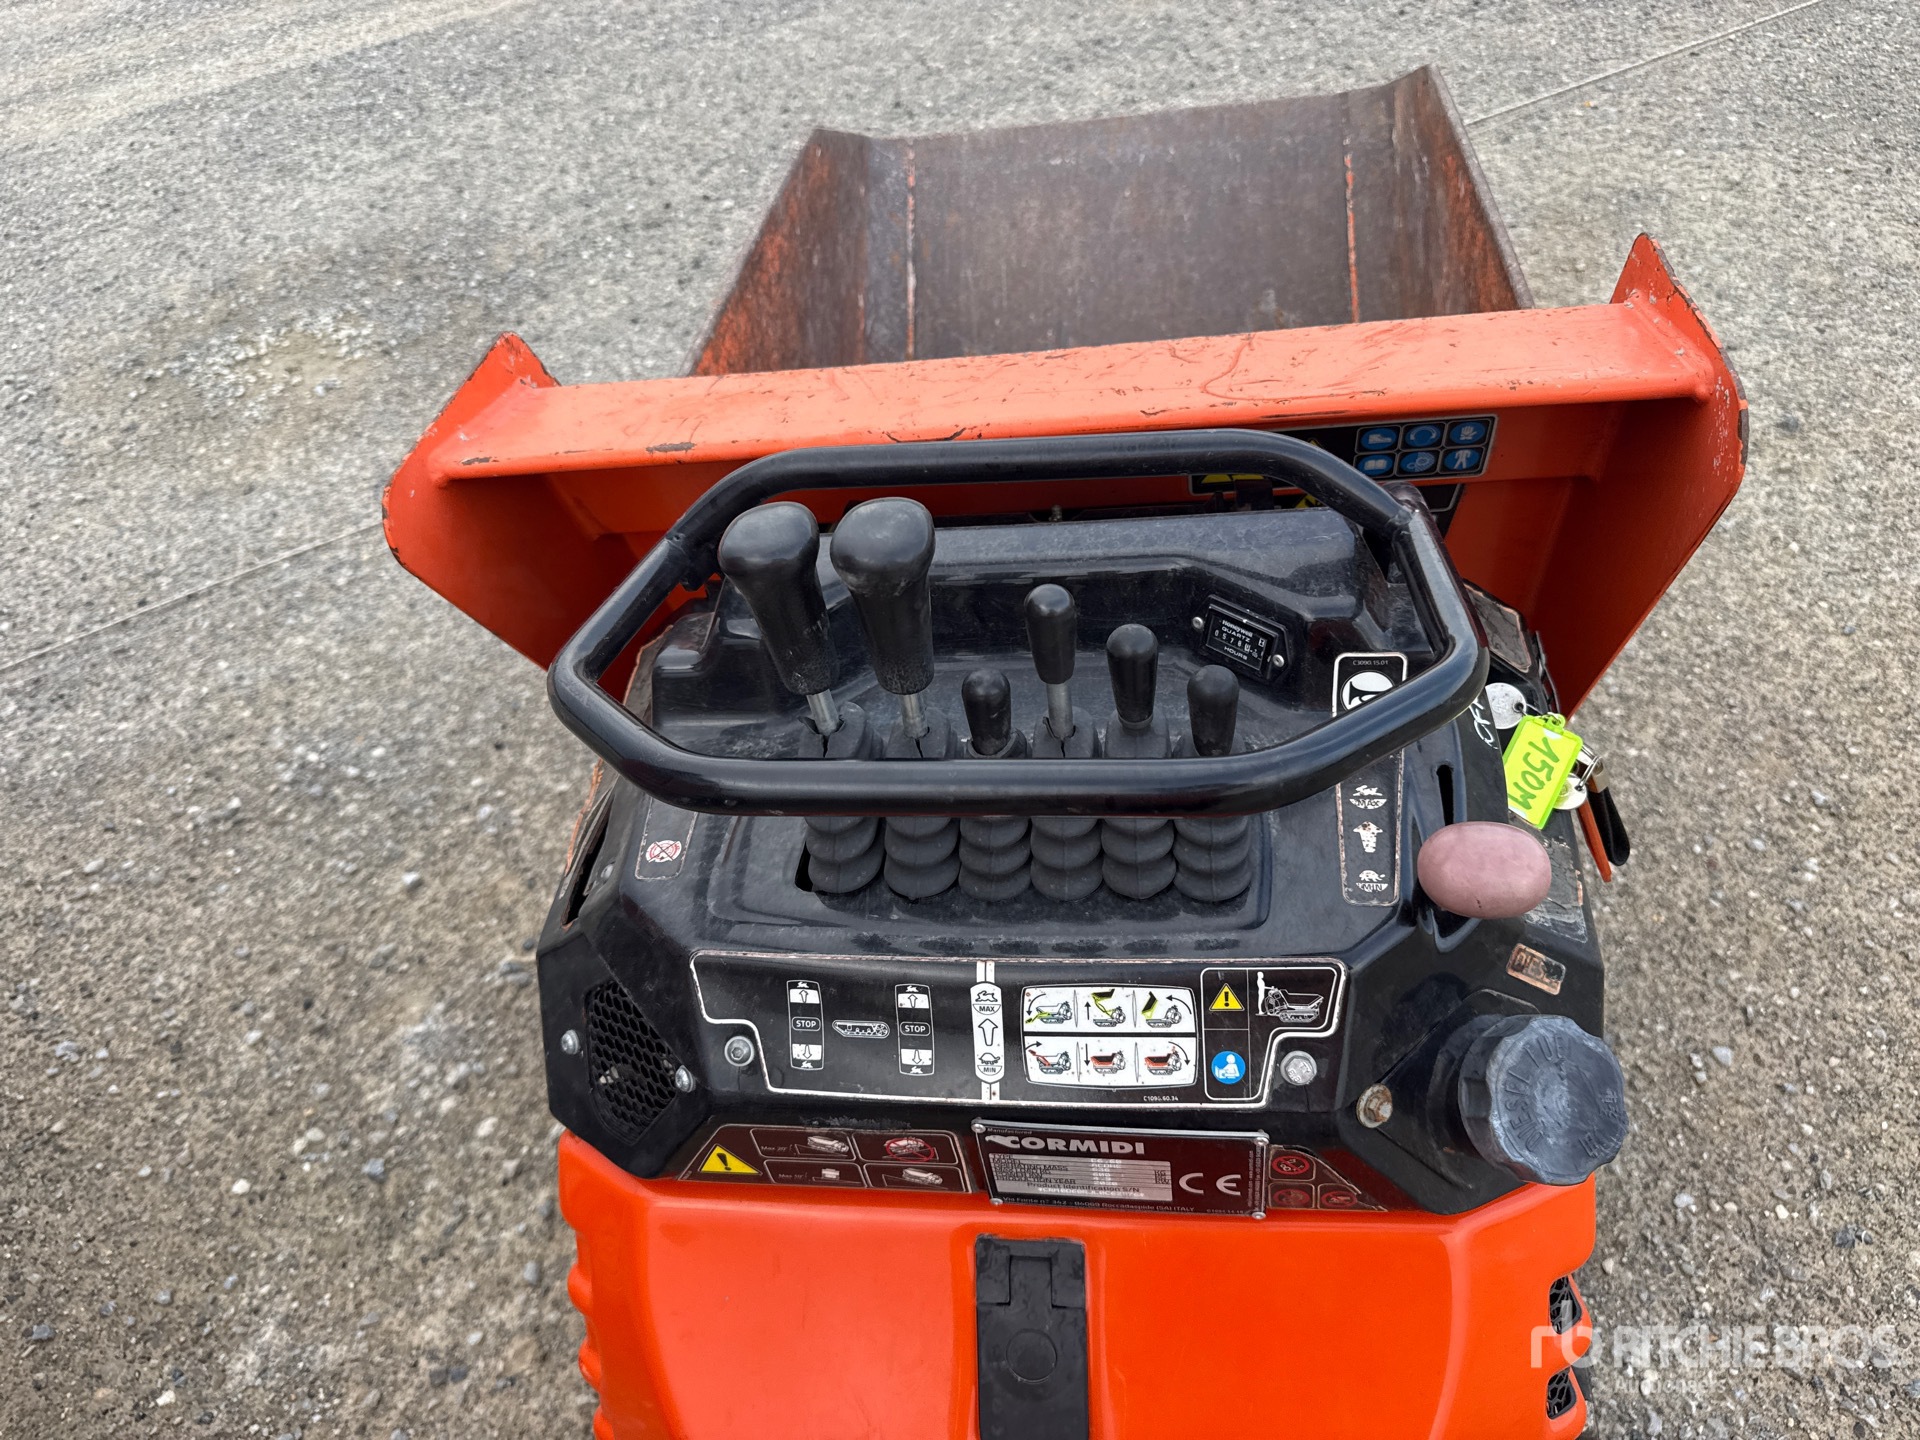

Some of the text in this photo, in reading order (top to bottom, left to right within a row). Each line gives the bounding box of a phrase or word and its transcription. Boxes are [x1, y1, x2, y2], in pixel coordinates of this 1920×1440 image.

[1221, 626, 1250, 643] QUARTZ
[1224, 646, 1247, 660] HOURS
[1361, 883, 1383, 891] MIN
[979, 1004, 995, 1013] MAX
[795, 1019, 817, 1029] STOP
[904, 1024, 926, 1034] STOP
[983, 1065, 997, 1074] MIN
[985, 1134, 1145, 1155] CORMIDI
[1063, 1184, 1121, 1192] Identification
[1178, 1172, 1242, 1196] CE
